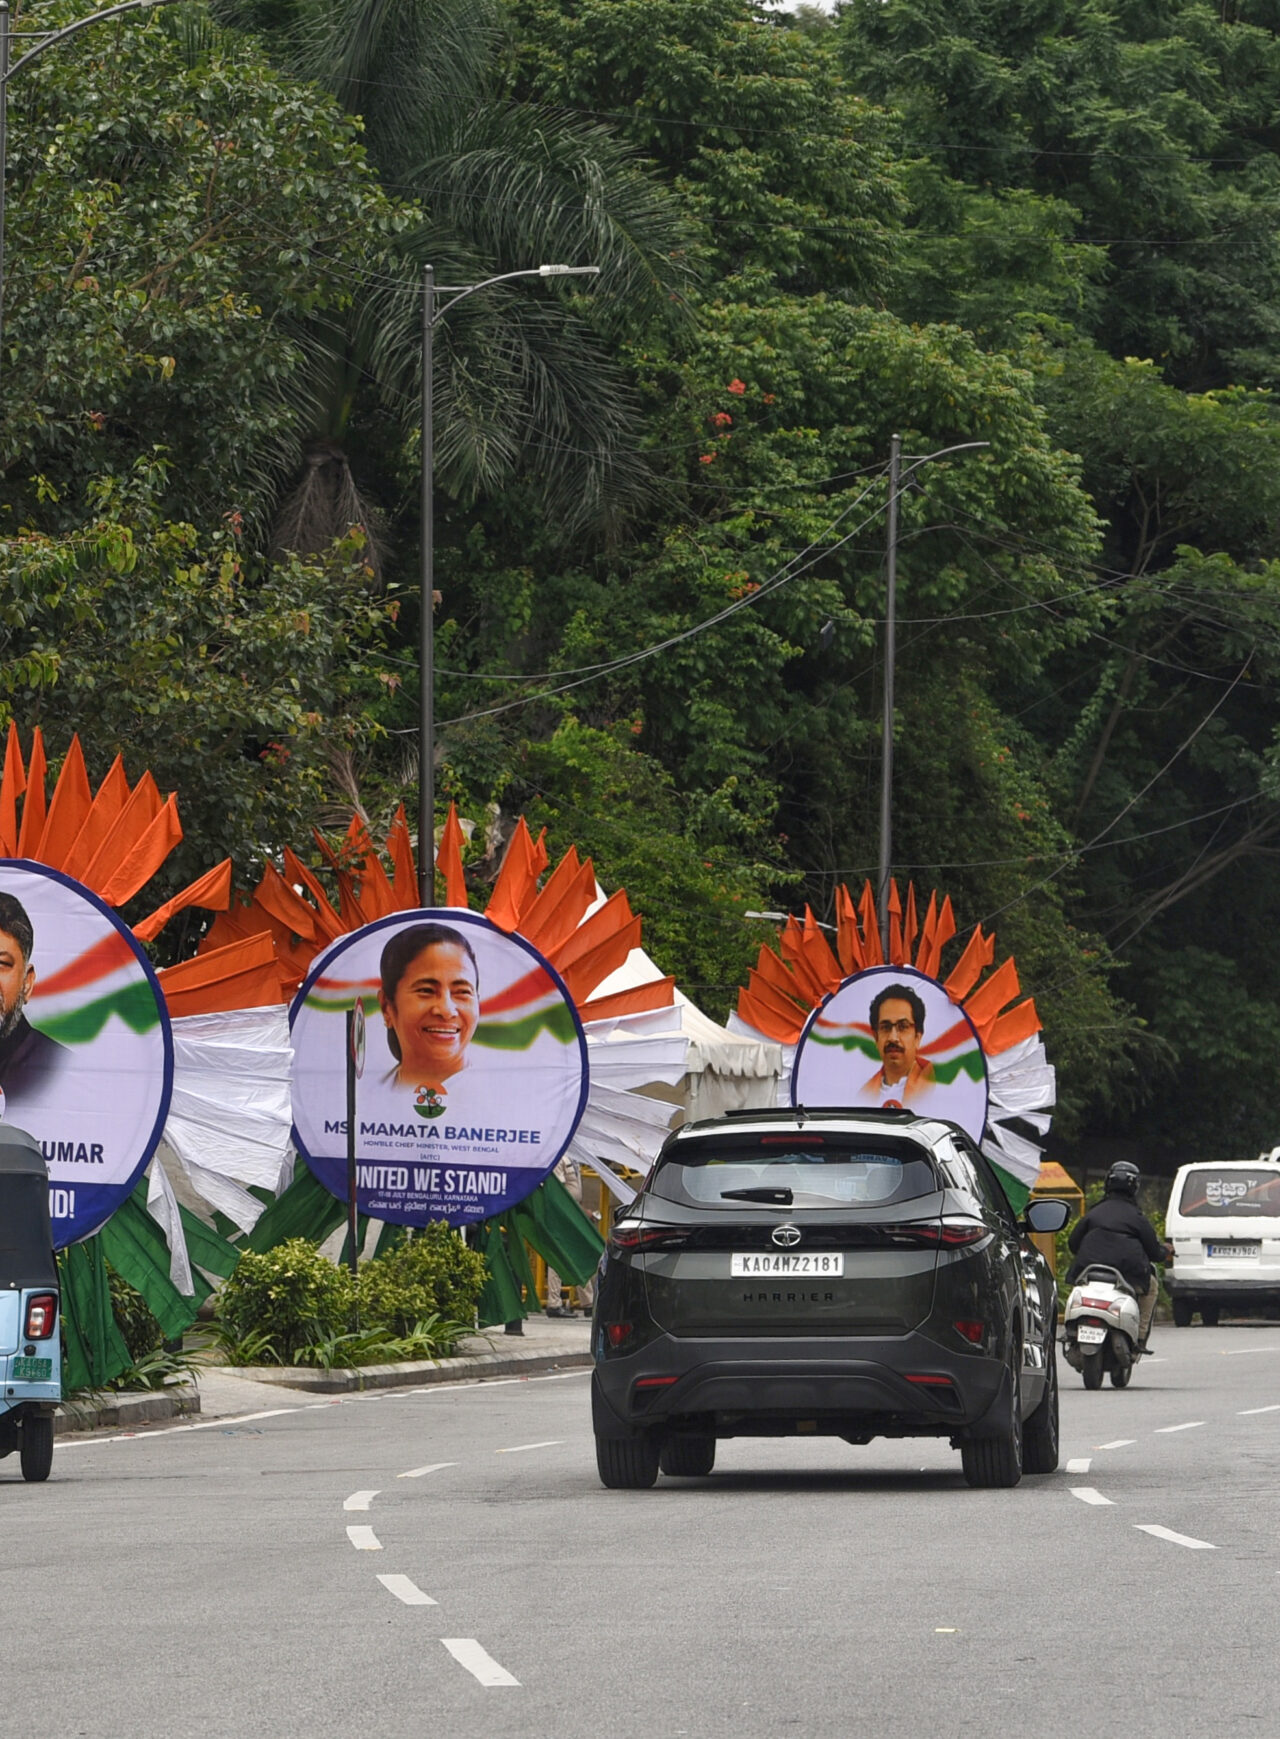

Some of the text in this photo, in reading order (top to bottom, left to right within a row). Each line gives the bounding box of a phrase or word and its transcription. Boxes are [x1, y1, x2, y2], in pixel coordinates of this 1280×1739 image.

[360, 1122, 440, 1140] MAMATA
[444, 1126, 541, 1144] BANERJEE
[395, 1141, 415, 1149] CHIEF
[413, 1168, 441, 1192] WE
[444, 1169, 507, 1195] STAND!
